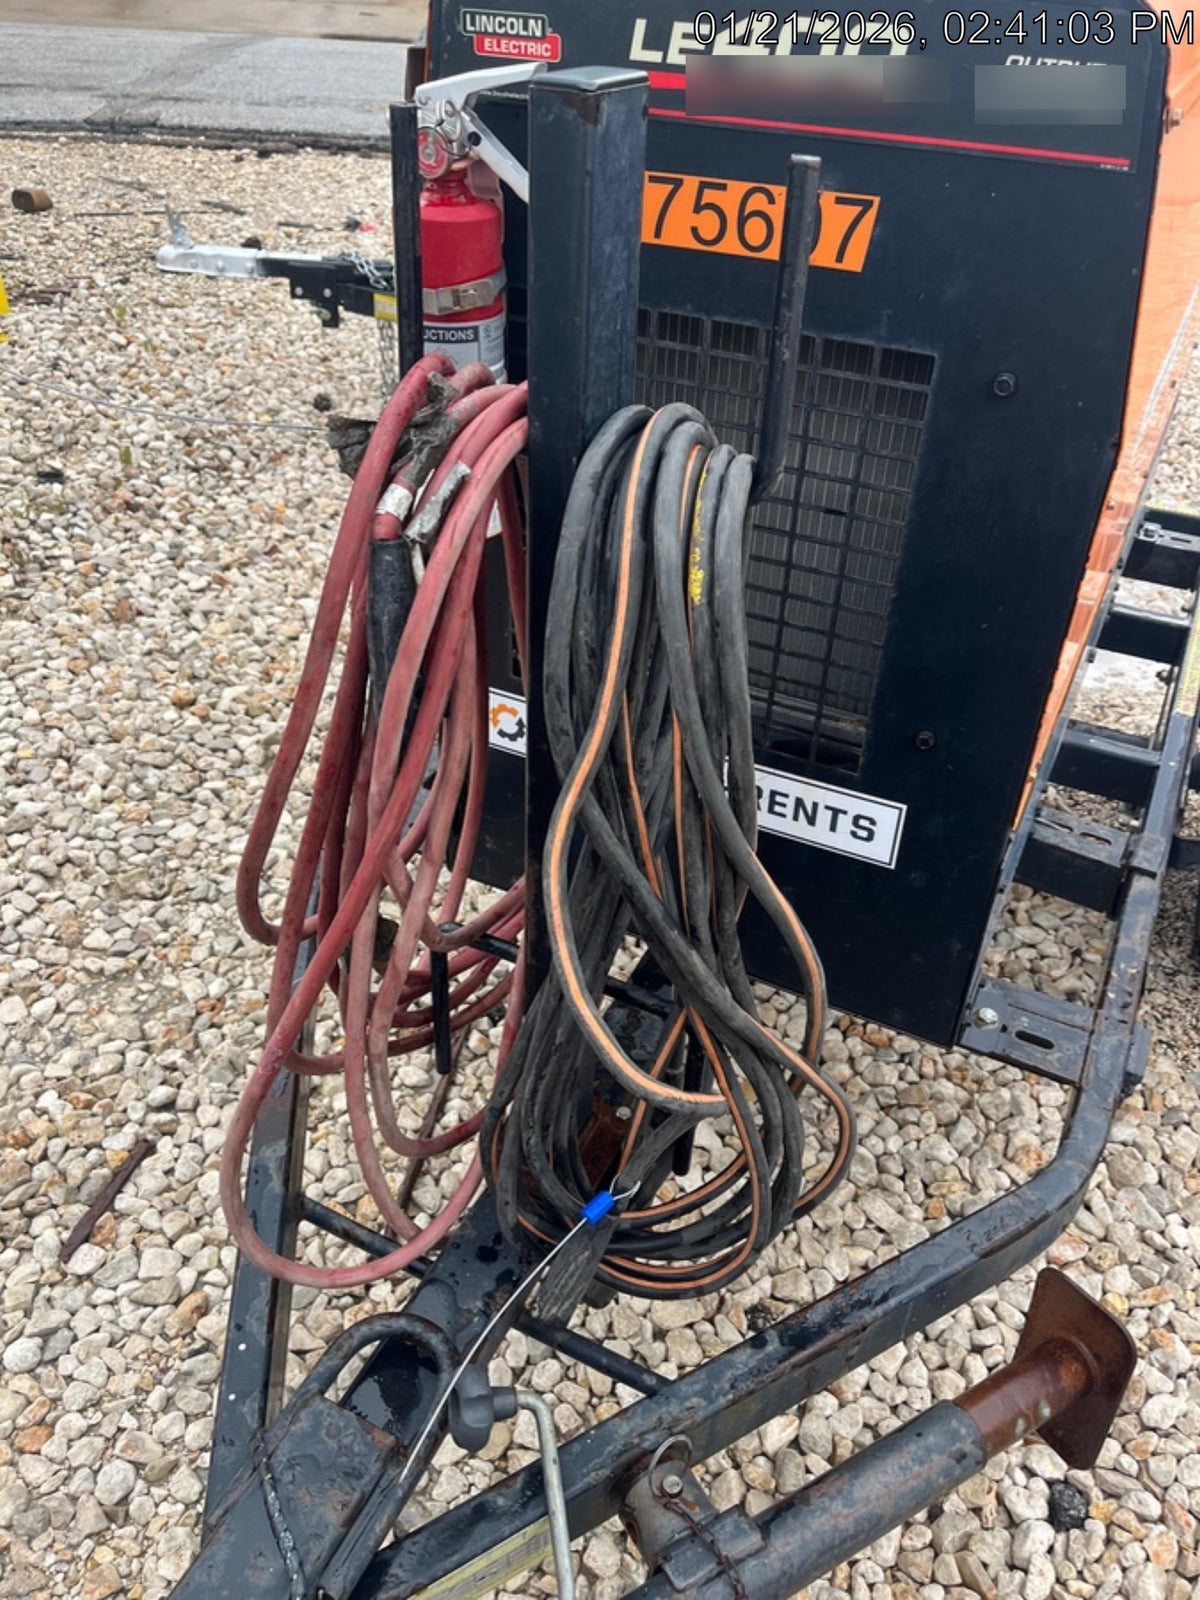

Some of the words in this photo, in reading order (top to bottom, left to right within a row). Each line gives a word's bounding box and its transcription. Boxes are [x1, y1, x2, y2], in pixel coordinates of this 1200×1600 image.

[465, 13, 543, 37] LINCOLN
[484, 38, 552, 57] ELECTRIC
[648, 175, 874, 264] 7567
